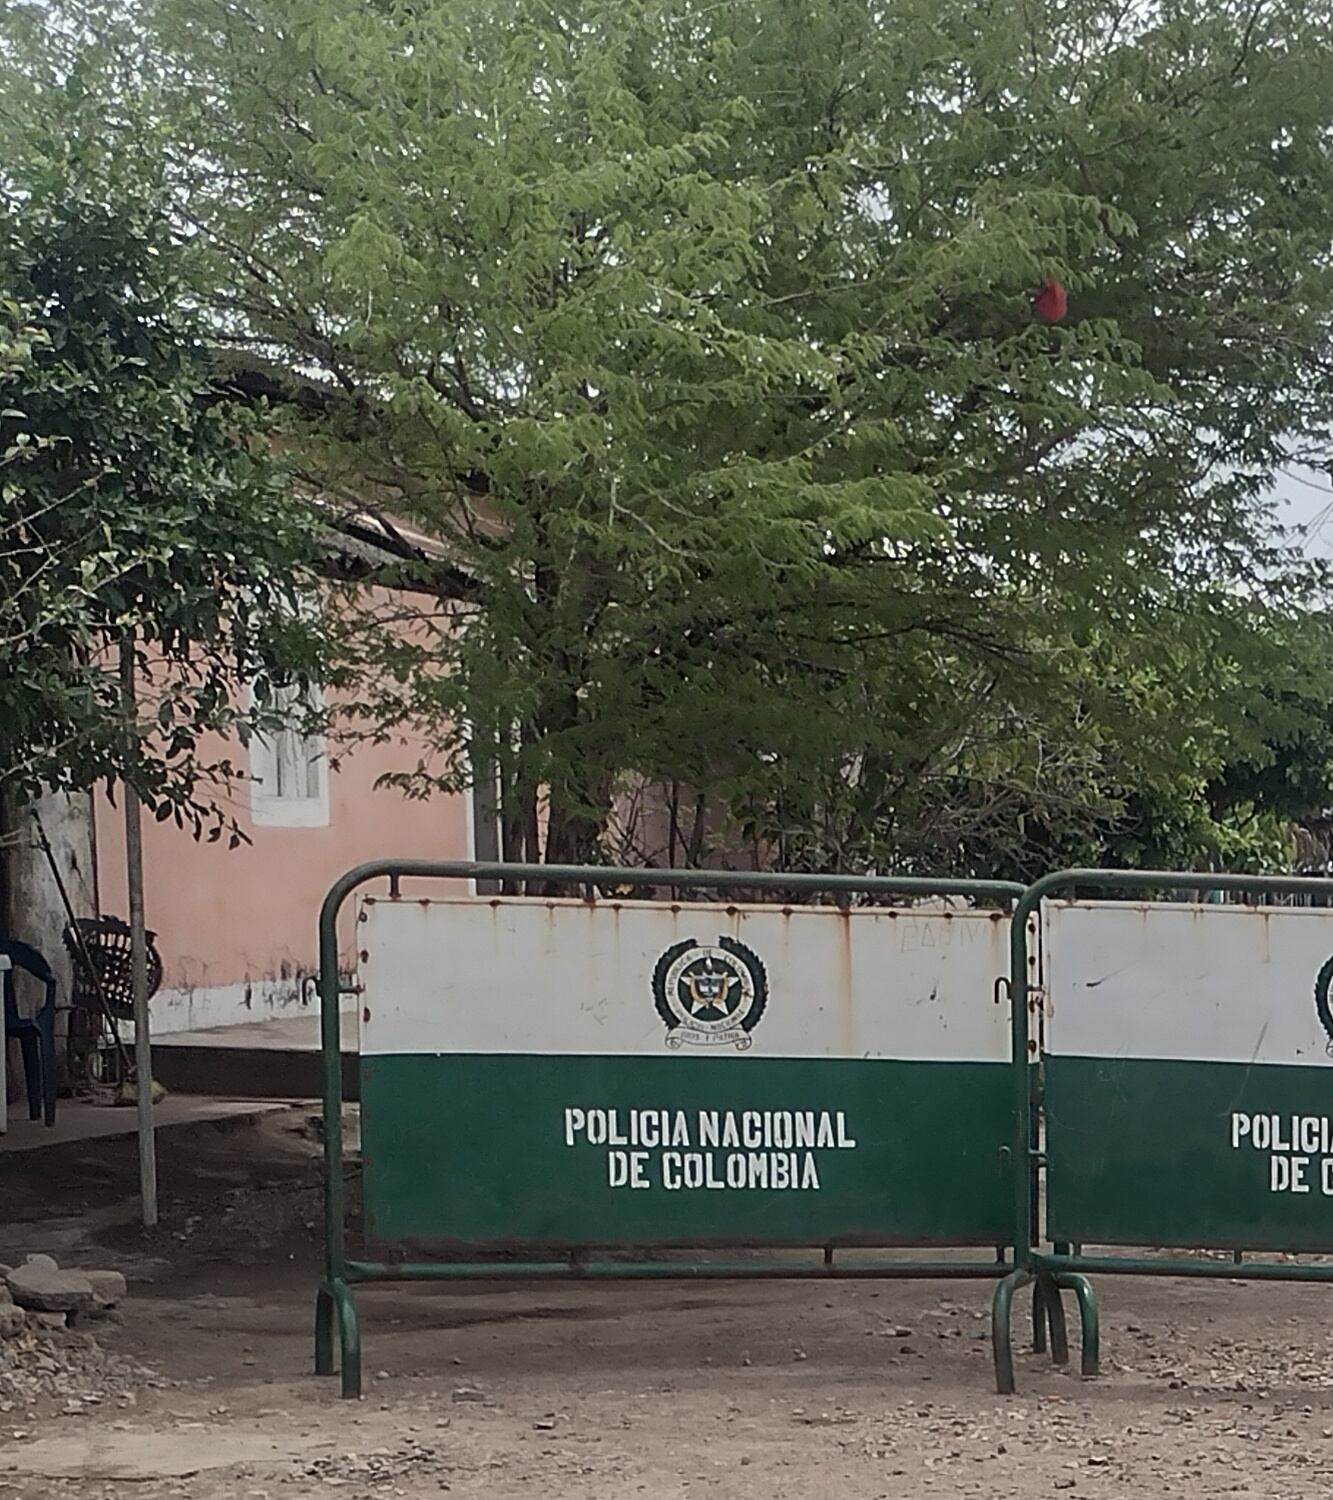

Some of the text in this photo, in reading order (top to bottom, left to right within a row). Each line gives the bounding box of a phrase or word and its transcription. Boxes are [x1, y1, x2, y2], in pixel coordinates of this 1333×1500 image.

[566, 1109, 855, 1148] POLICIA NACIONAL
[609, 1152, 819, 1189] DE COLOMBIA
[1272, 1157, 1310, 1192] DE
